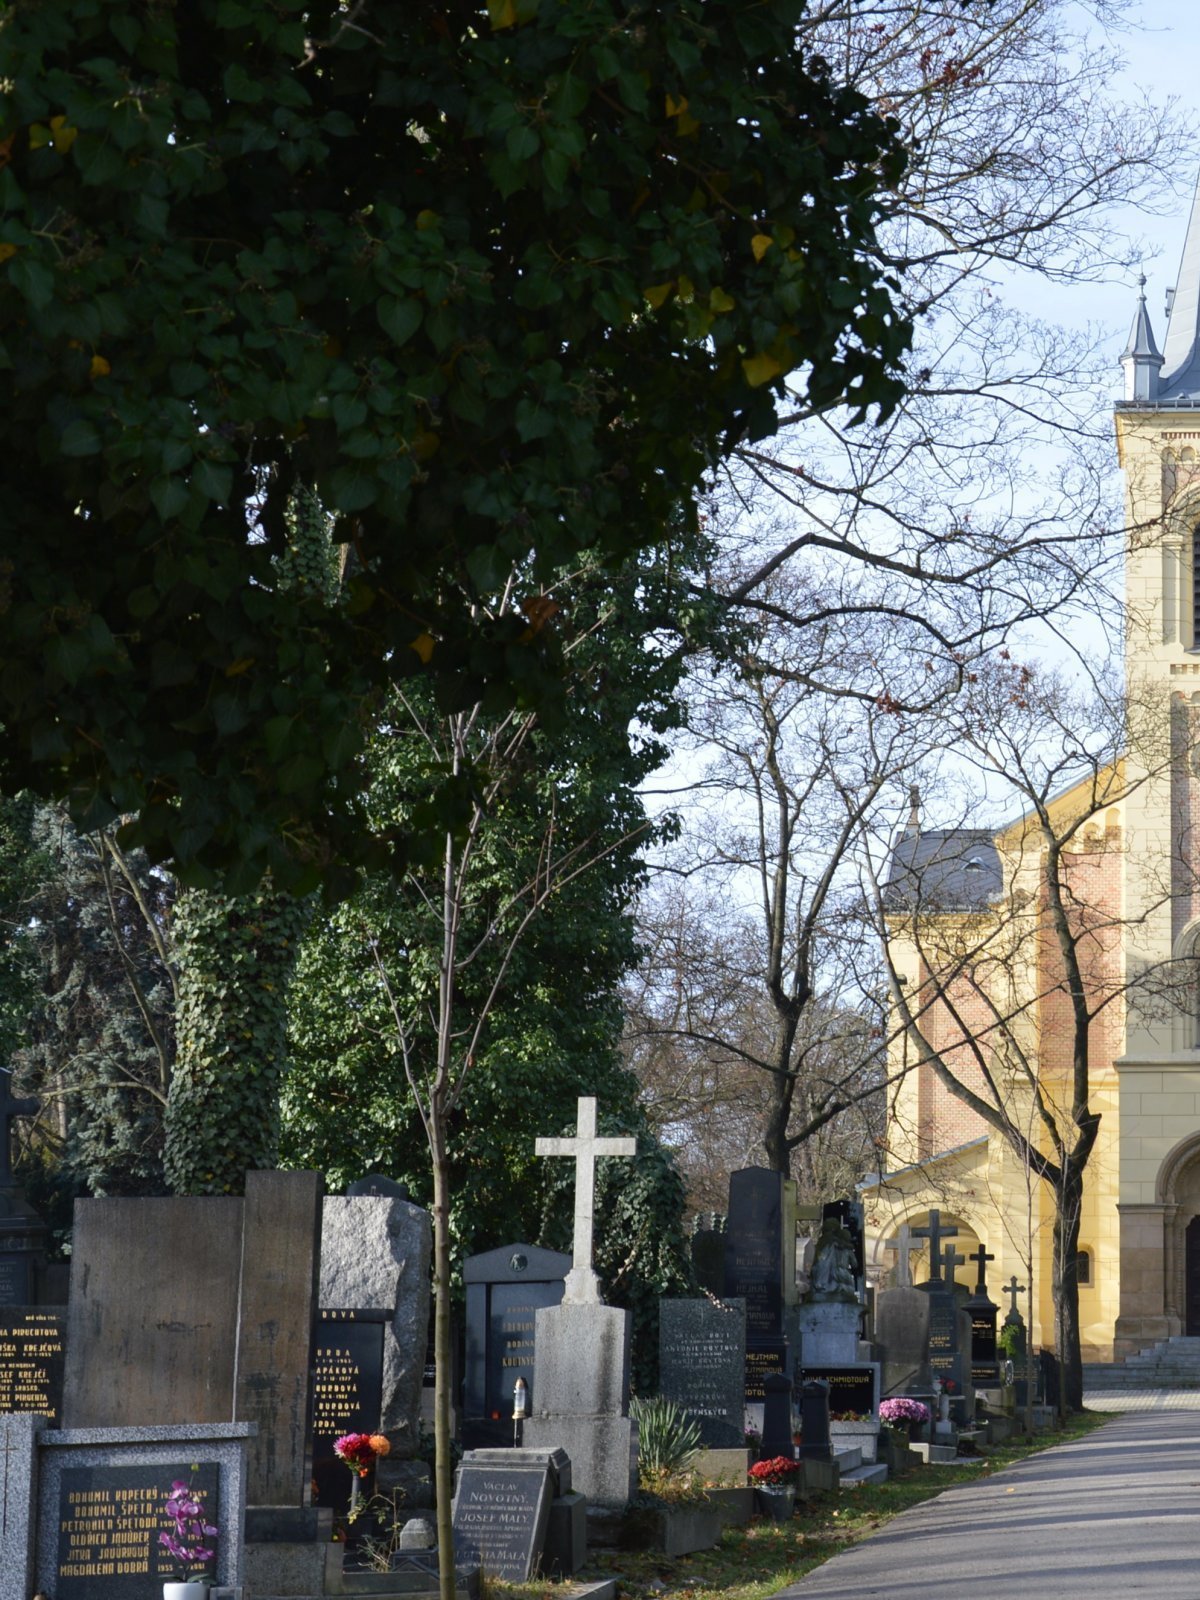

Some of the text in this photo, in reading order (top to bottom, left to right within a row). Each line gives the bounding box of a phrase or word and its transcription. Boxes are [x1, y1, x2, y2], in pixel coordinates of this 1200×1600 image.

[69, 1490, 111, 1504] BOHUMIL
[75, 1504, 117, 1518] BOHUMIL
[459, 1512, 497, 1523] JOSEF
[60, 1561, 115, 1577] MAGDALENA
[117, 1558, 150, 1575] DOBRÁ
